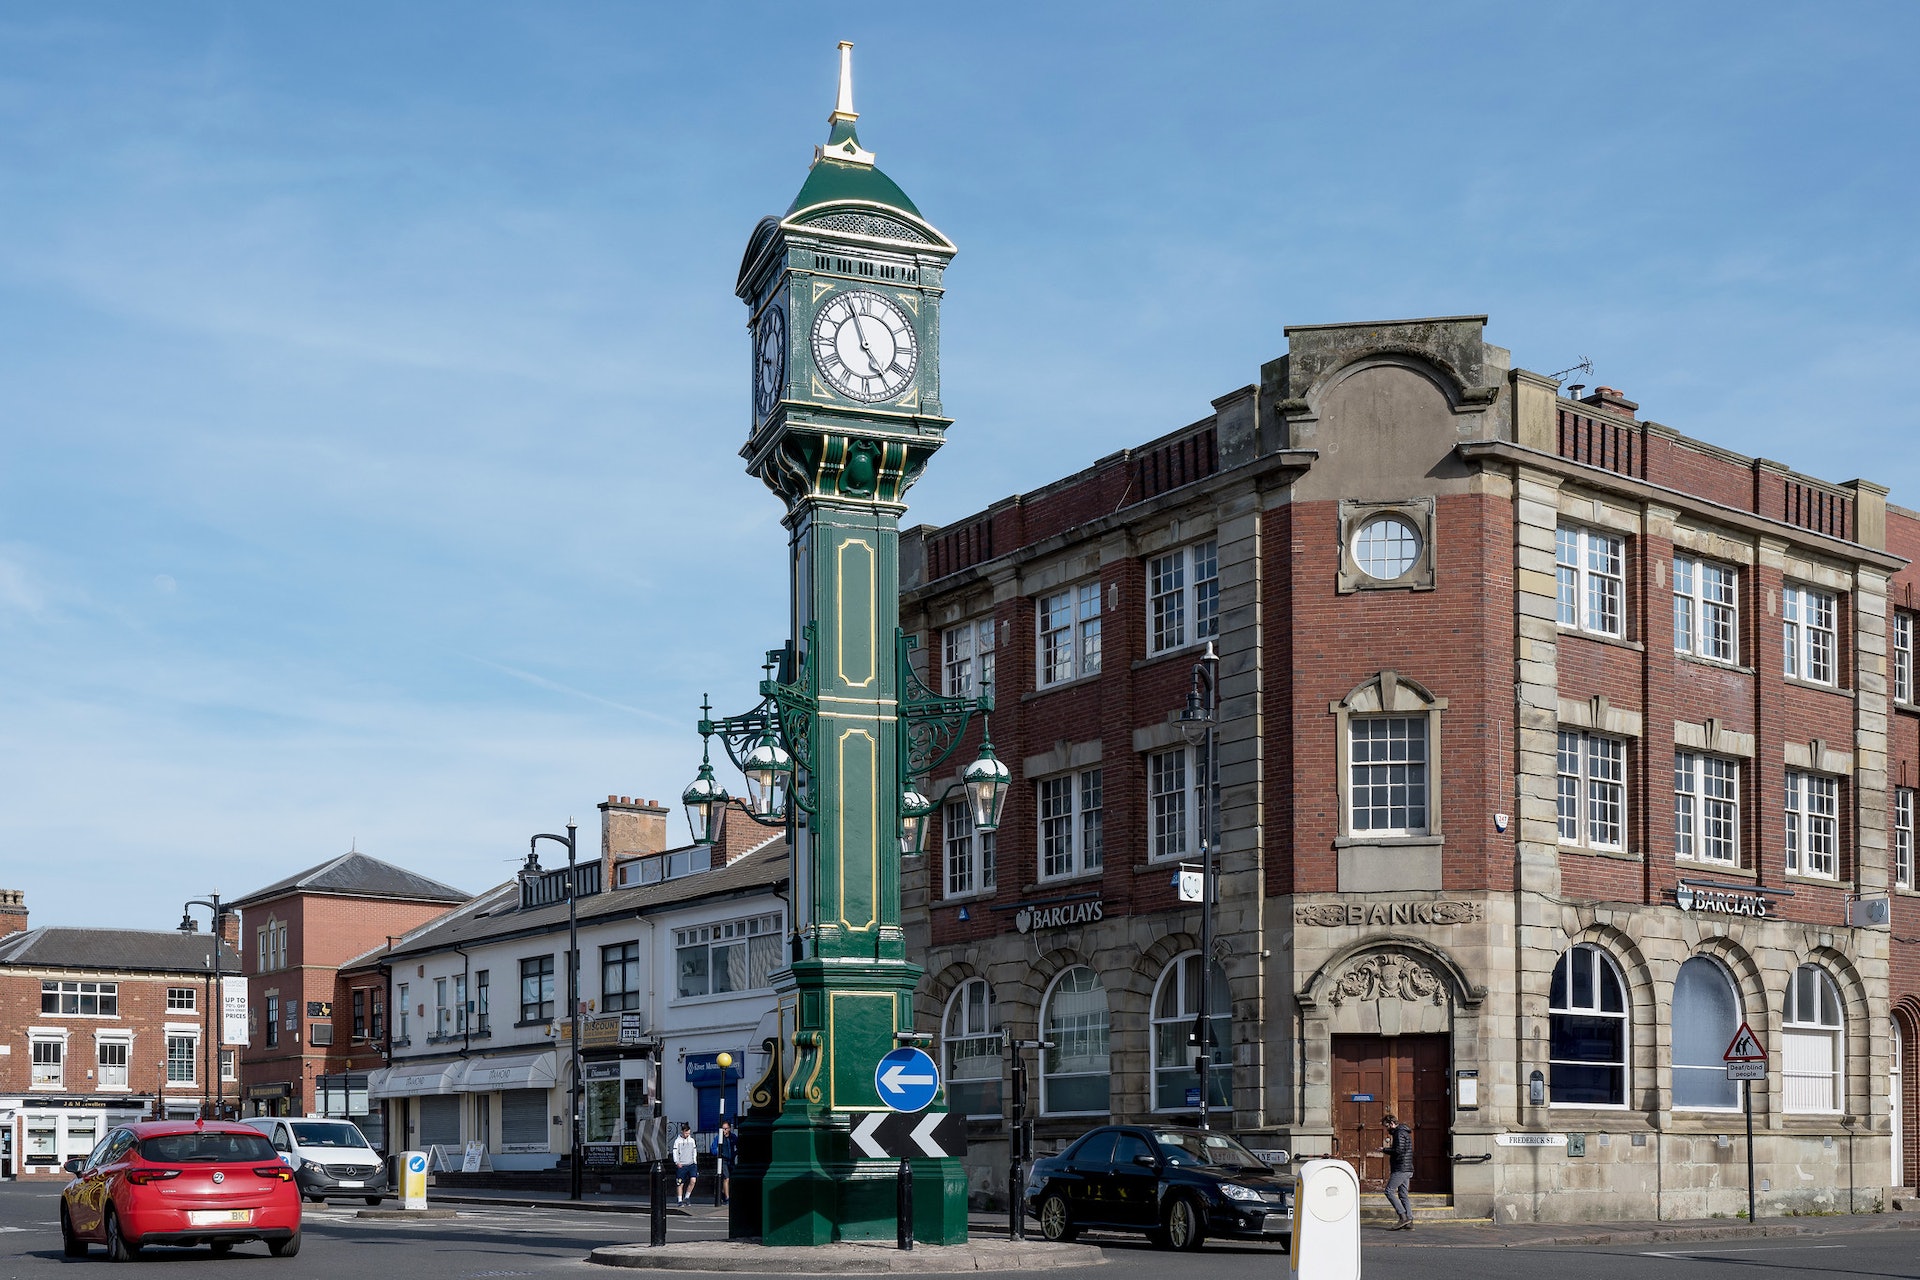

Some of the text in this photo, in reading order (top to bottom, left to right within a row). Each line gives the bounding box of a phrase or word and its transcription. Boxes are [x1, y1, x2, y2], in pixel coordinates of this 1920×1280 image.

[1033, 900, 1103, 929] BARCLAYS
[1346, 903, 1433, 926] BANK
[1695, 889, 1766, 917] BARCLAYS
[584, 1021, 619, 1031] DISCOUNT
[1509, 1136, 1545, 1144] FREDERICK
